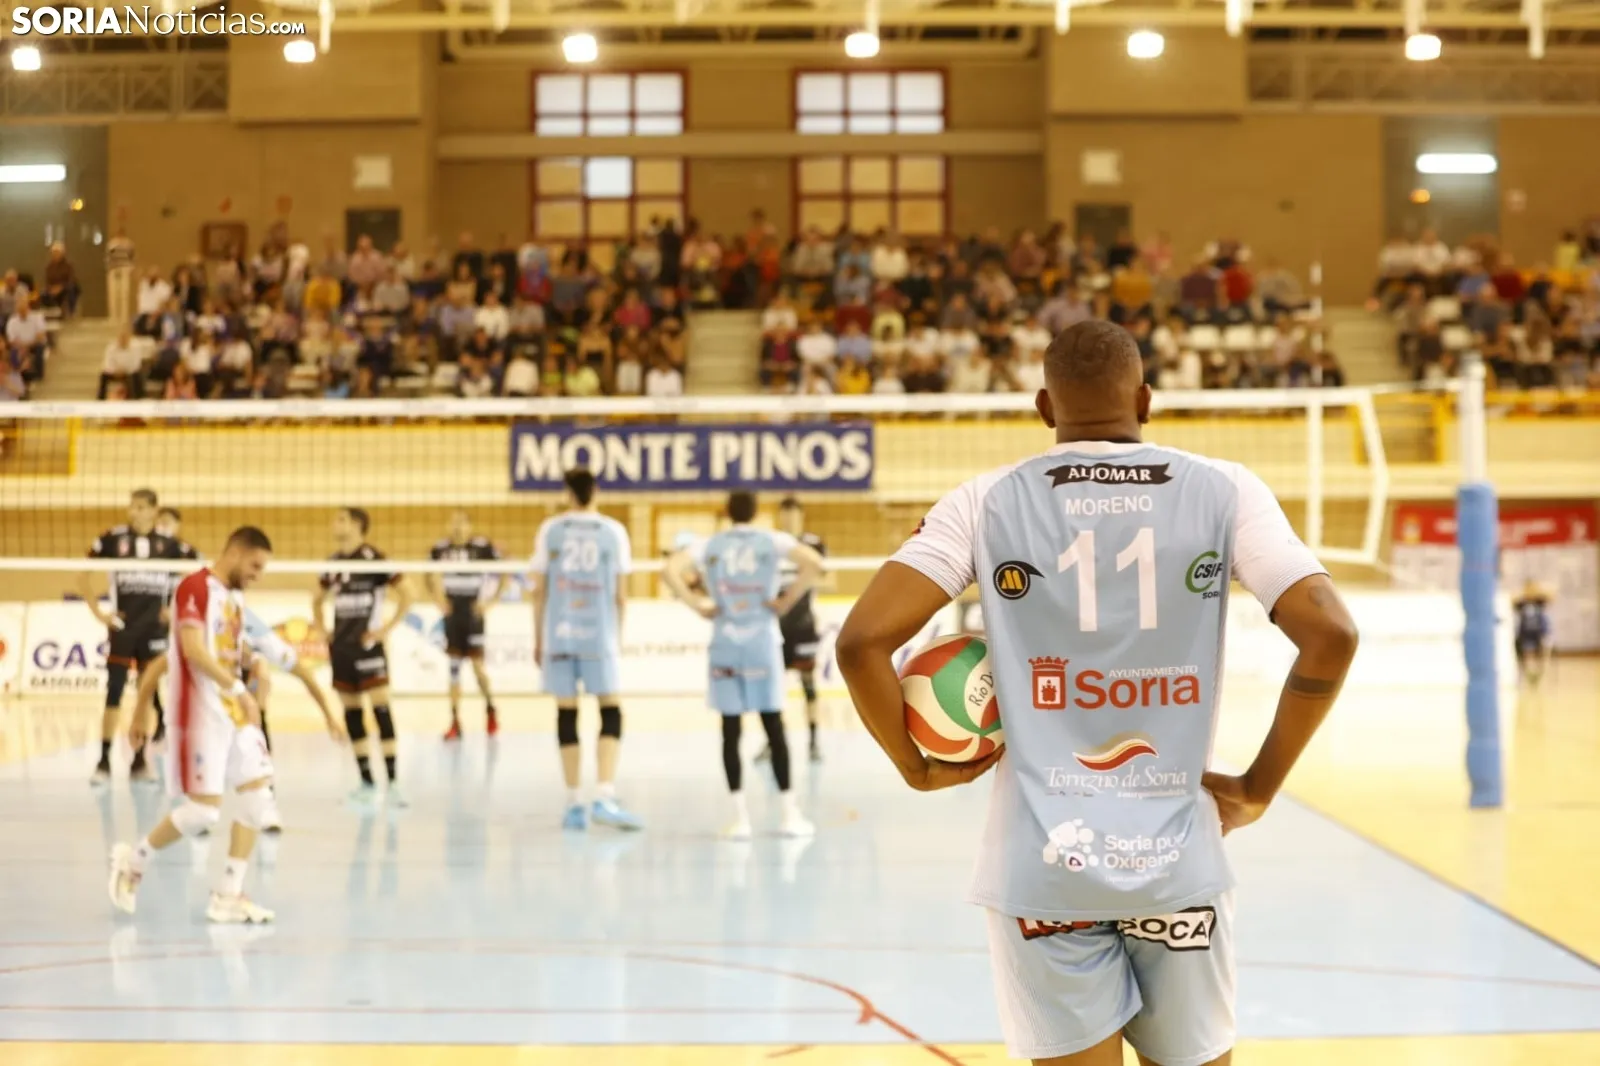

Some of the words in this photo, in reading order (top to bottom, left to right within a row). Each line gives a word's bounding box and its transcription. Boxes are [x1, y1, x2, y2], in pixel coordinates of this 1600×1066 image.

[514, 431, 700, 482] MONTE
[709, 431, 872, 482] PINOS
[1067, 466, 1153, 482] ALJOMAR
[1065, 494, 1153, 516] MORENO
[561, 540, 599, 573] 20
[722, 545, 759, 577] 14
[1058, 527, 1158, 632] 11
[1108, 665, 1199, 679] AYUNTAMIENTO
[1073, 669, 1201, 710] Soria
[1122, 763, 1140, 788] de
[1143, 764, 1188, 787] Soria
[1104, 834, 1153, 851] Soria
[1104, 850, 1180, 873] Oxígeno
